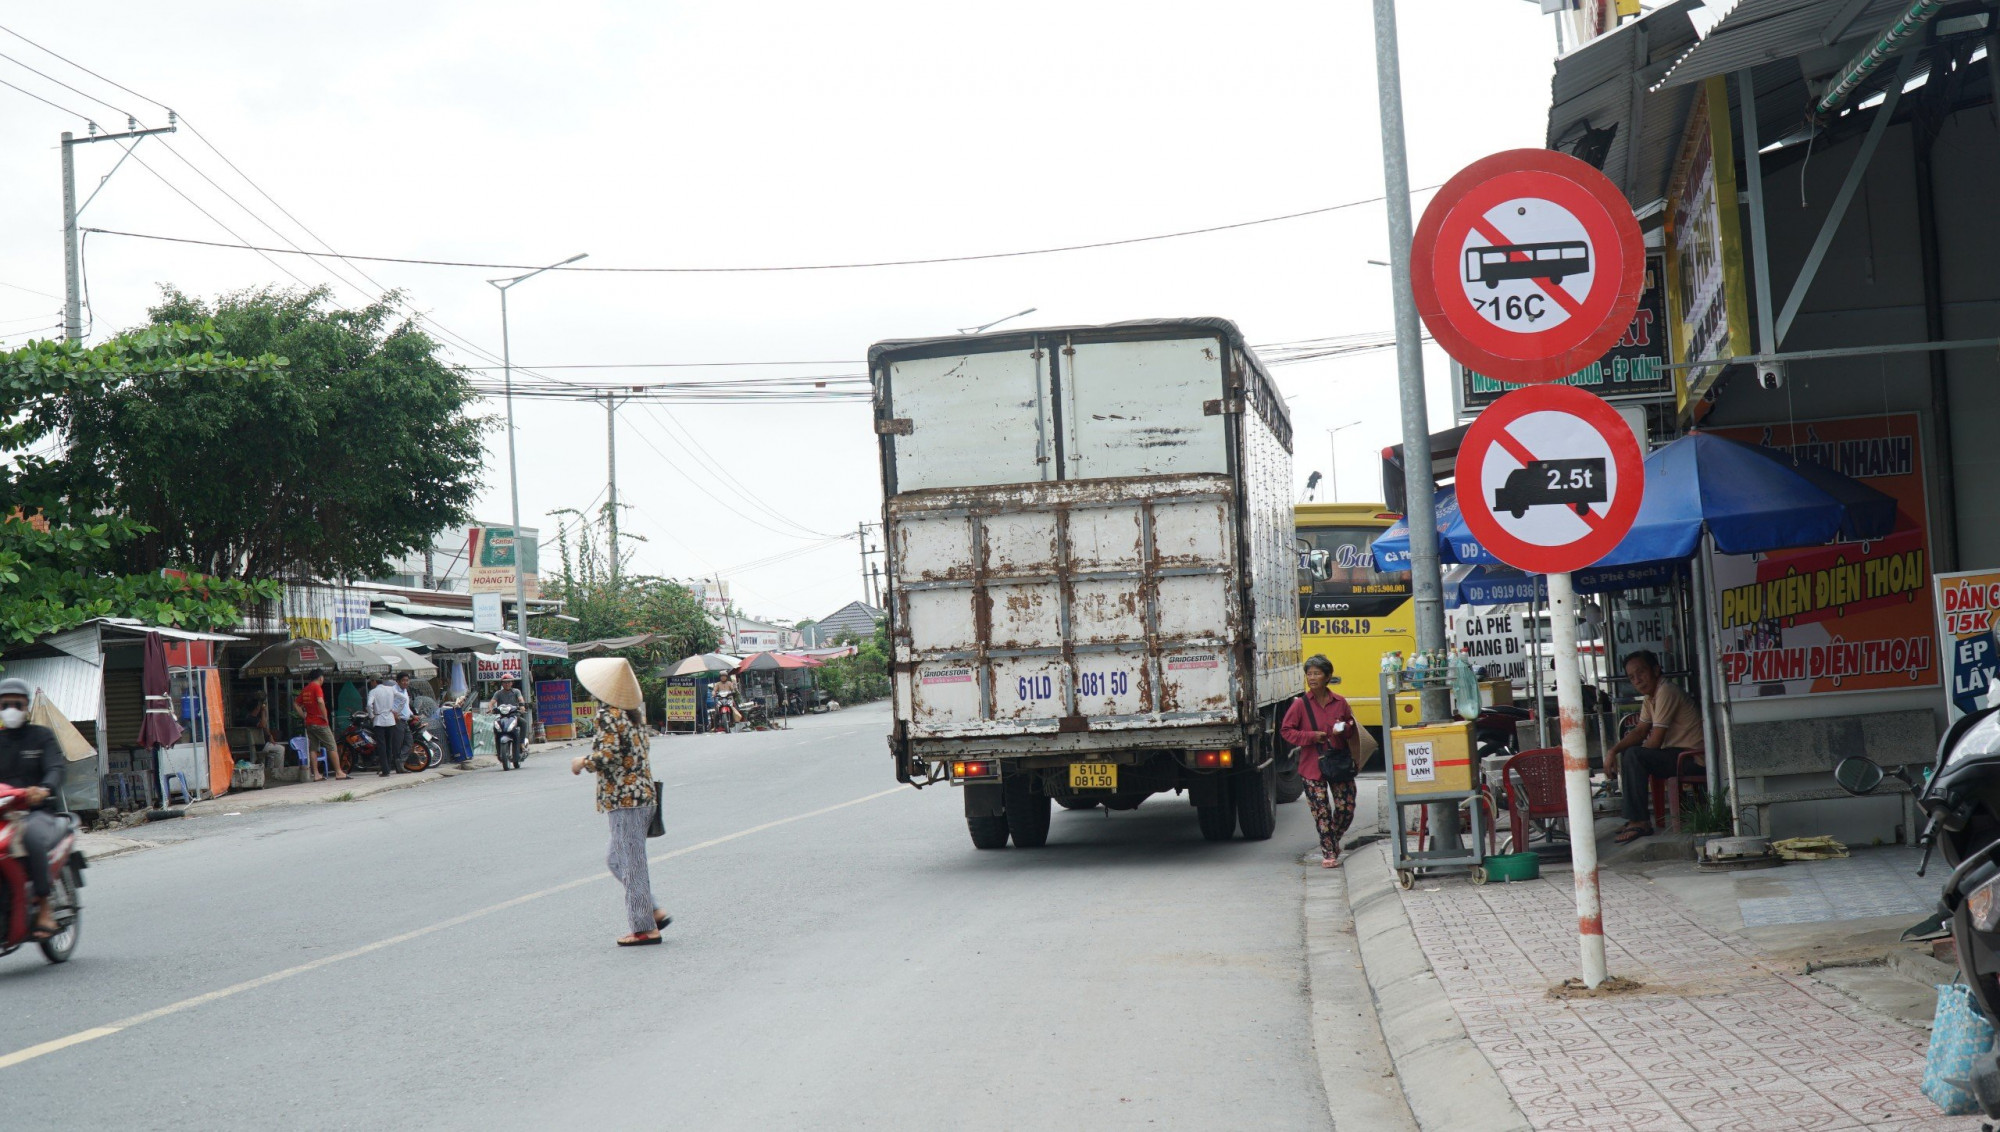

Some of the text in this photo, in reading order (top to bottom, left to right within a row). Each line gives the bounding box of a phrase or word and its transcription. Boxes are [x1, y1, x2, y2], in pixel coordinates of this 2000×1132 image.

[1613, 356, 1629, 382] ÉP
[1631, 354, 1663, 382] KÍNH
[1838, 435, 1914, 478] NHANH
[1547, 468, 1593, 490] 2.5t
[1385, 551, 1412, 562] Cà Ph
[473, 575, 503, 585] HOÀNG
[1491, 585, 1514, 599] 0919
[1516, 584, 1534, 598] 036
[1722, 549, 1924, 634] PHỤ KIỆN ĐIỆN THOẠI
[1944, 579, 1986, 614] DÁN
[1314, 603, 1350, 612] SAMCO
[1300, 618, 1371, 635] 1B-168.19
[1466, 613, 1512, 637] CÀ PHÊ
[1947, 610, 1992, 635] 15K
[1463, 637, 1519, 657] MANG ĐI
[1959, 640, 1988, 665] ÉP
[1169, 654, 1216, 663] BRIDGESTONE
[1752, 638, 1808, 683] KÍNH
[1809, 635, 1860, 686] ĐIỆN
[1863, 636, 1930, 680] THOẠI
[924, 668, 970, 678] BRIDGESTONE
[1503, 661, 1526, 680] LẠNH
[1018, 675, 1052, 701] 61LD
[1111, 671, 1128, 696] 50
[1408, 745, 1430, 756] NƯỚC
[1080, 764, 1107, 775] 61LD
[1411, 767, 1431, 778] LẠNH
[1074, 776, 1112, 787] 081.50
